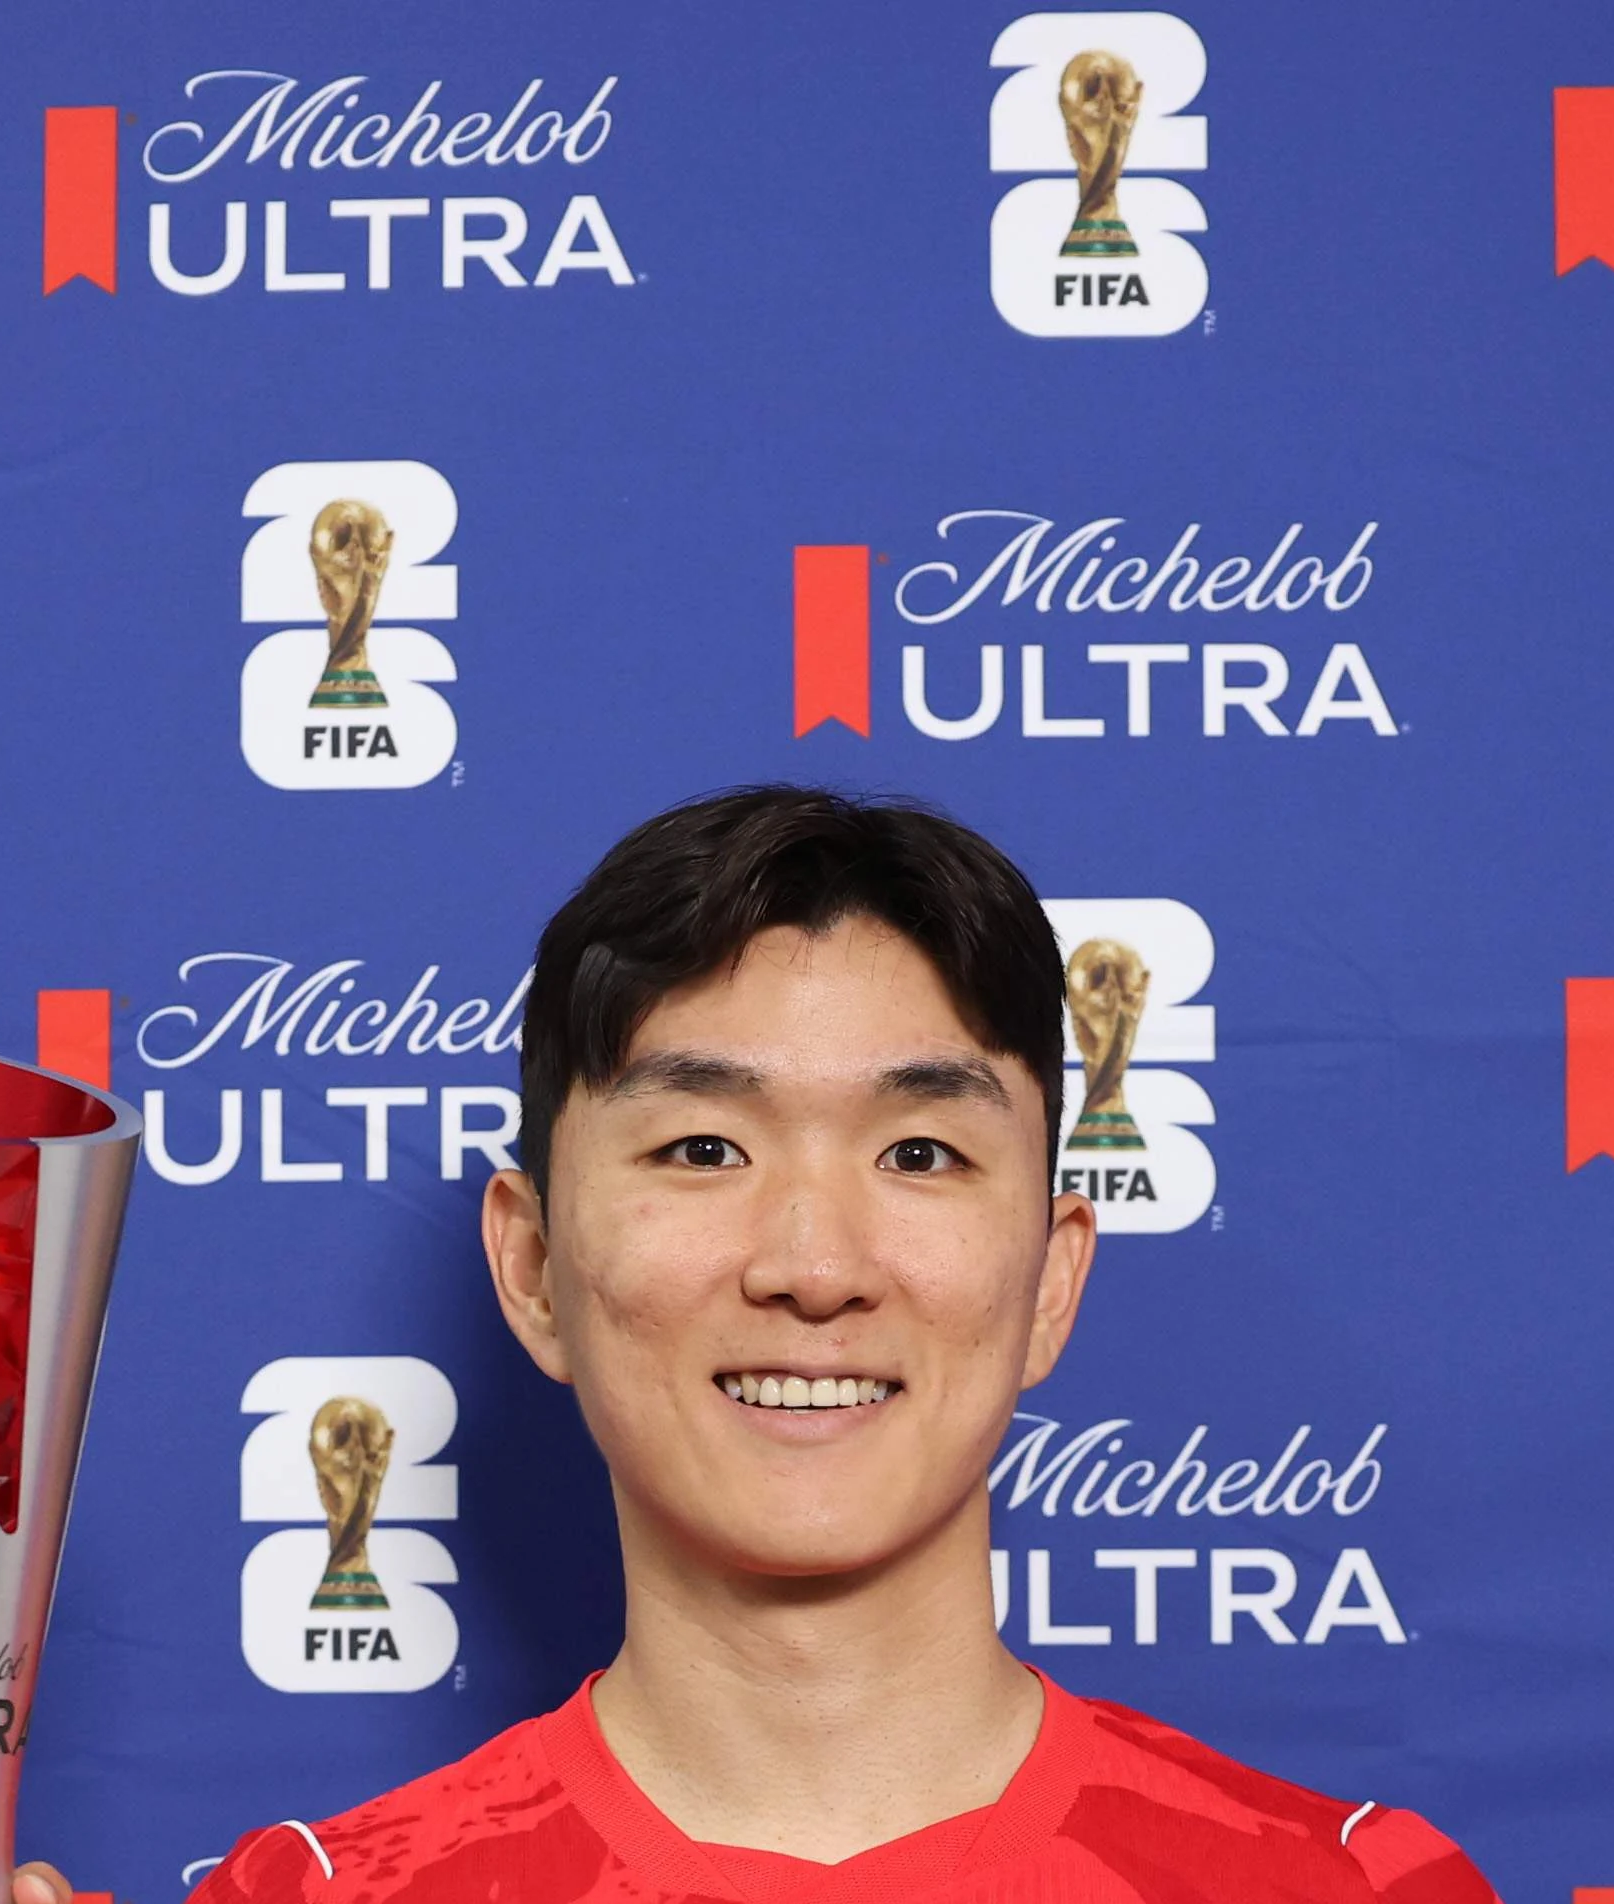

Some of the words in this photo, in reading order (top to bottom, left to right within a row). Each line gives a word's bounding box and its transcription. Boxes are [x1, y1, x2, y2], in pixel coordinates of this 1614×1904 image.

[142, 69, 619, 185] Michelob
[148, 194, 637, 298] ULTRA
[1054, 274, 1150, 307] FIFA
[893, 509, 1380, 626] Michelob
[303, 725, 399, 759] FIFA
[901, 642, 1400, 742] ULTRA
[137, 952, 536, 1069] Michel
[142, 1086, 523, 1186] ULTR
[1060, 1168, 1157, 1202] FIFA
[305, 1627, 401, 1661] FIFA
